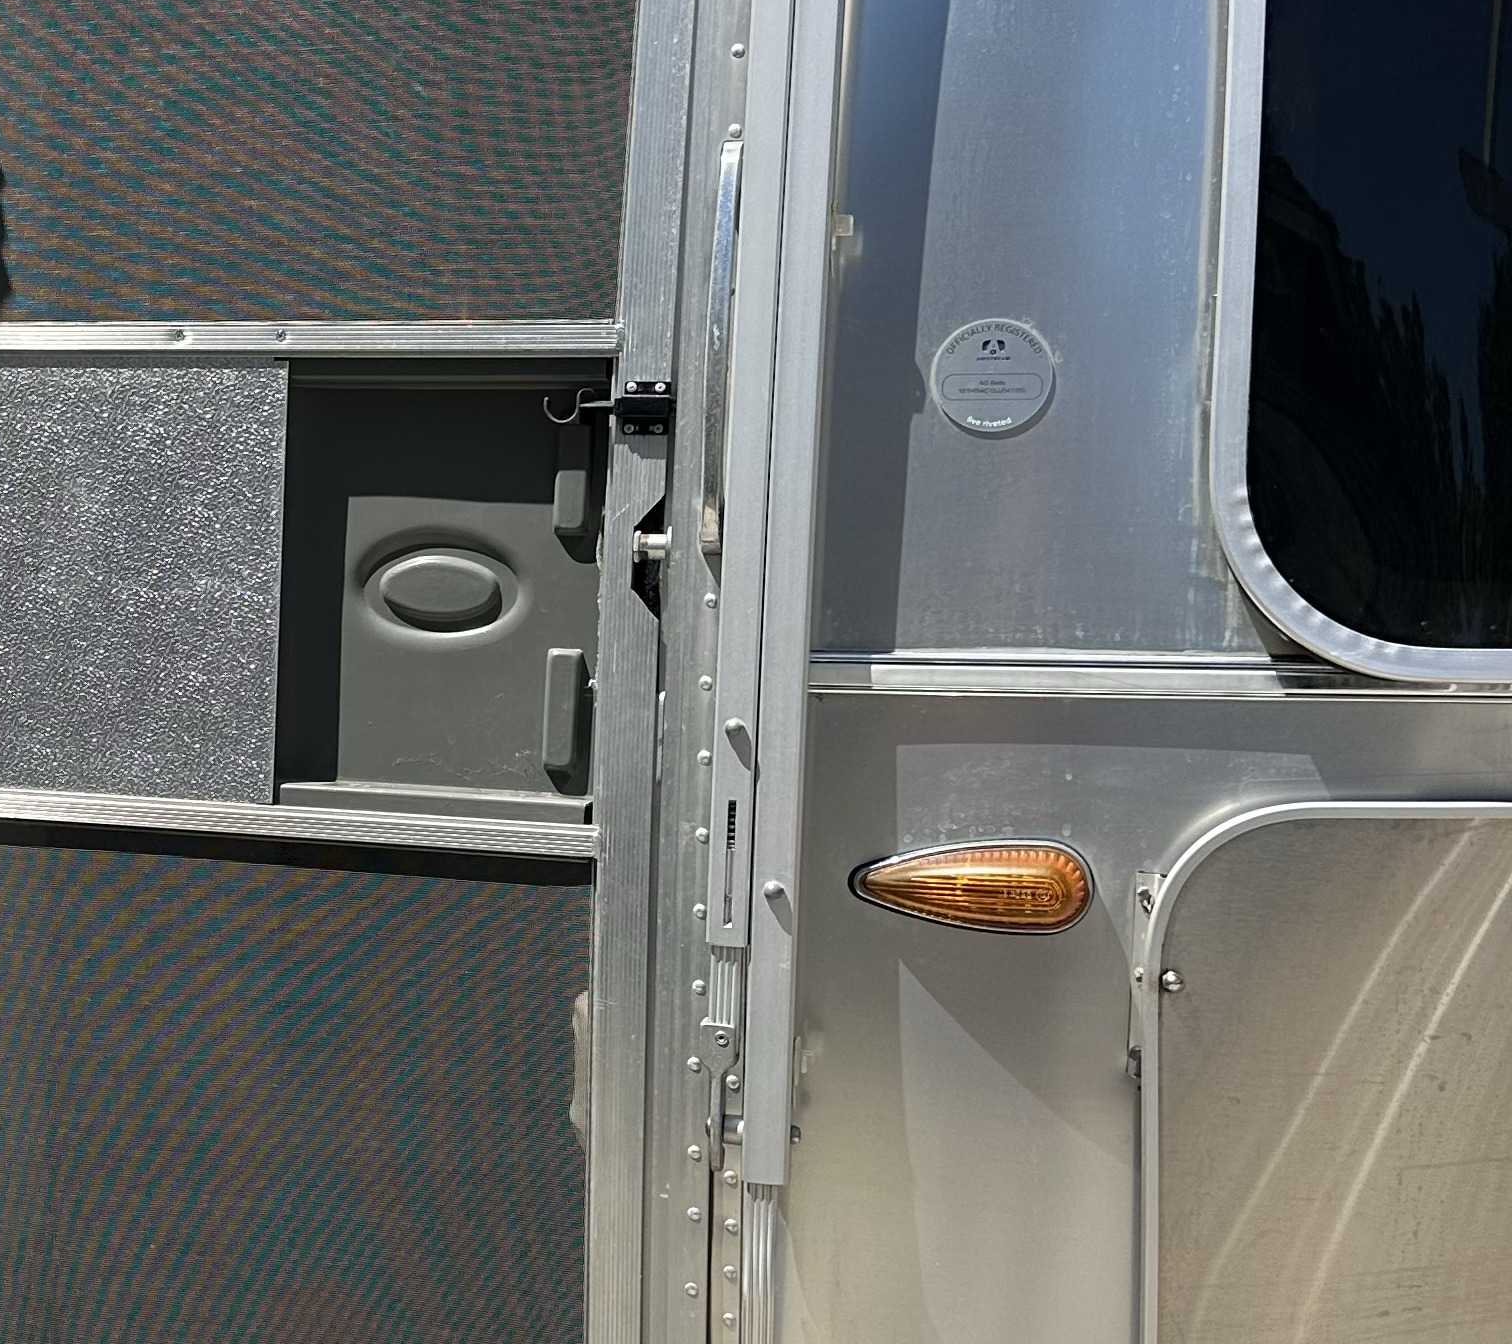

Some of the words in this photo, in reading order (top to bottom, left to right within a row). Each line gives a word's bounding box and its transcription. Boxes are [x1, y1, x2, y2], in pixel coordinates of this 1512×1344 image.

[946, 324, 992, 355] OFFICIALLY
[994, 323, 1042, 354] REGISTERED
[982, 417, 1012, 427] riveted
